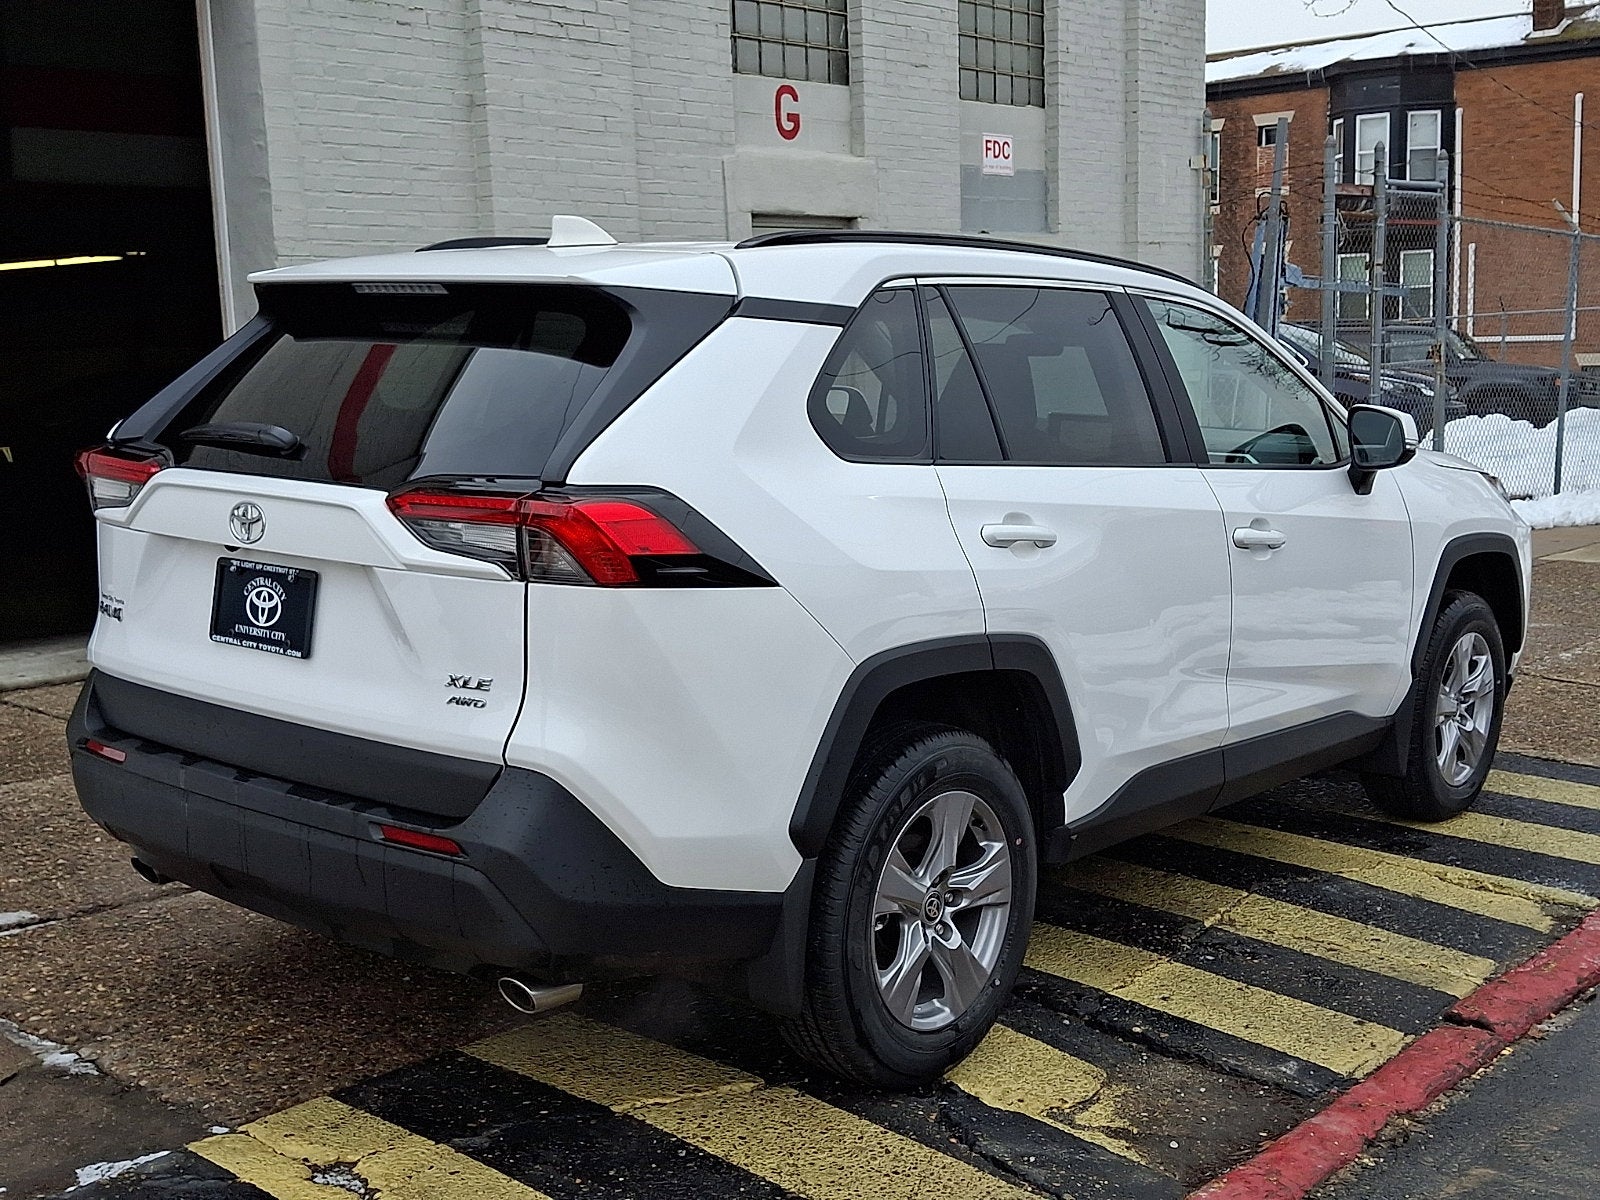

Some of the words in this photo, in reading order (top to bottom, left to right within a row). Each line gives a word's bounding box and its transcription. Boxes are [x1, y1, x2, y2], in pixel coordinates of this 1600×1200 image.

[775, 85, 800, 140] G
[985, 139, 1010, 160] FDC
[243, 577, 273, 596] CENTRAL
[272, 581, 287, 601] CITY
[235, 624, 271, 638] UNIVERSITY
[271, 631, 287, 641] CITY
[212, 634, 241, 645] CENTRAL
[242, 640, 257, 649] CITY
[258, 643, 284, 654] TOYOTA
[444, 673, 493, 692] XLE
[446, 695, 487, 708] AWD
